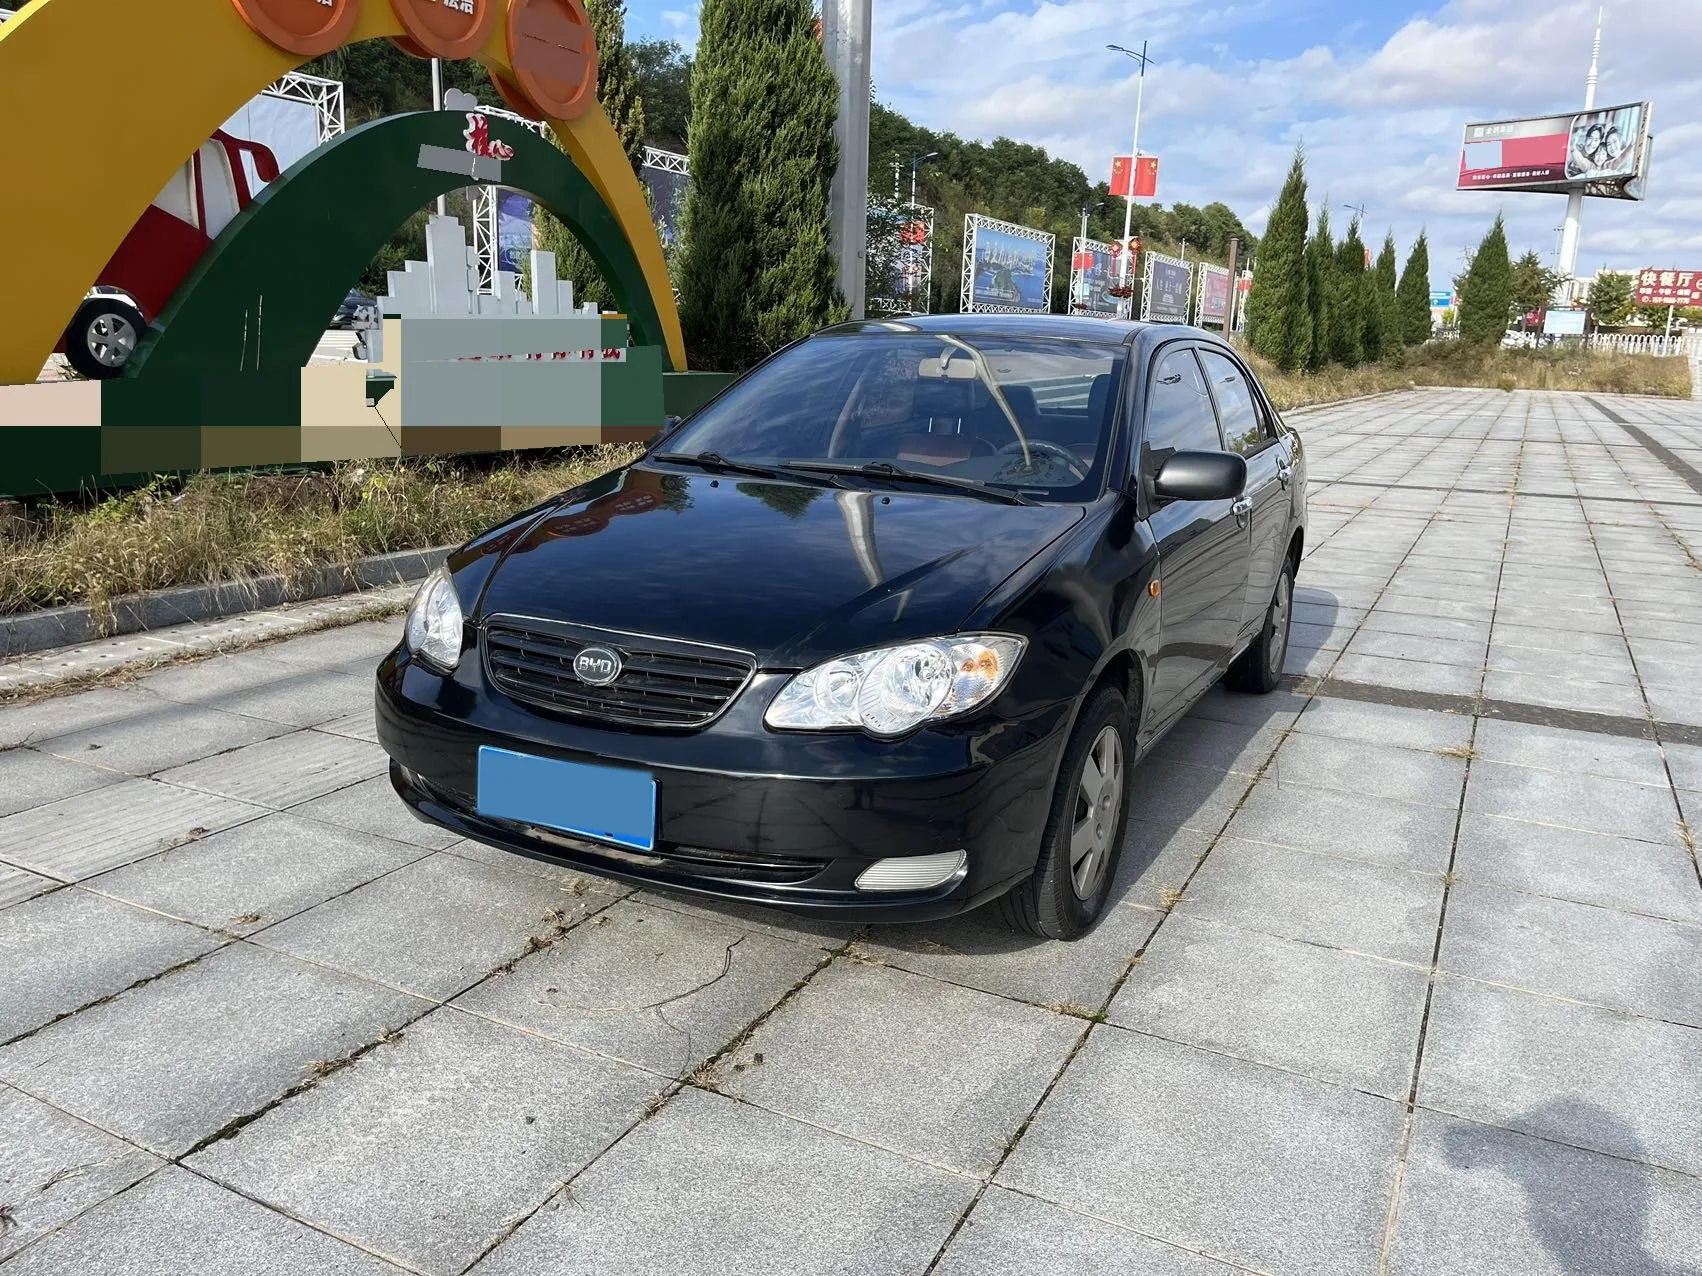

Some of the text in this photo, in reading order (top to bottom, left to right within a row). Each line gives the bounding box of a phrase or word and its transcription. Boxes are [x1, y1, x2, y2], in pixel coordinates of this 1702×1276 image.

[1640, 271, 1695, 287] 快餐厅
[578, 656, 612, 673] BYD
